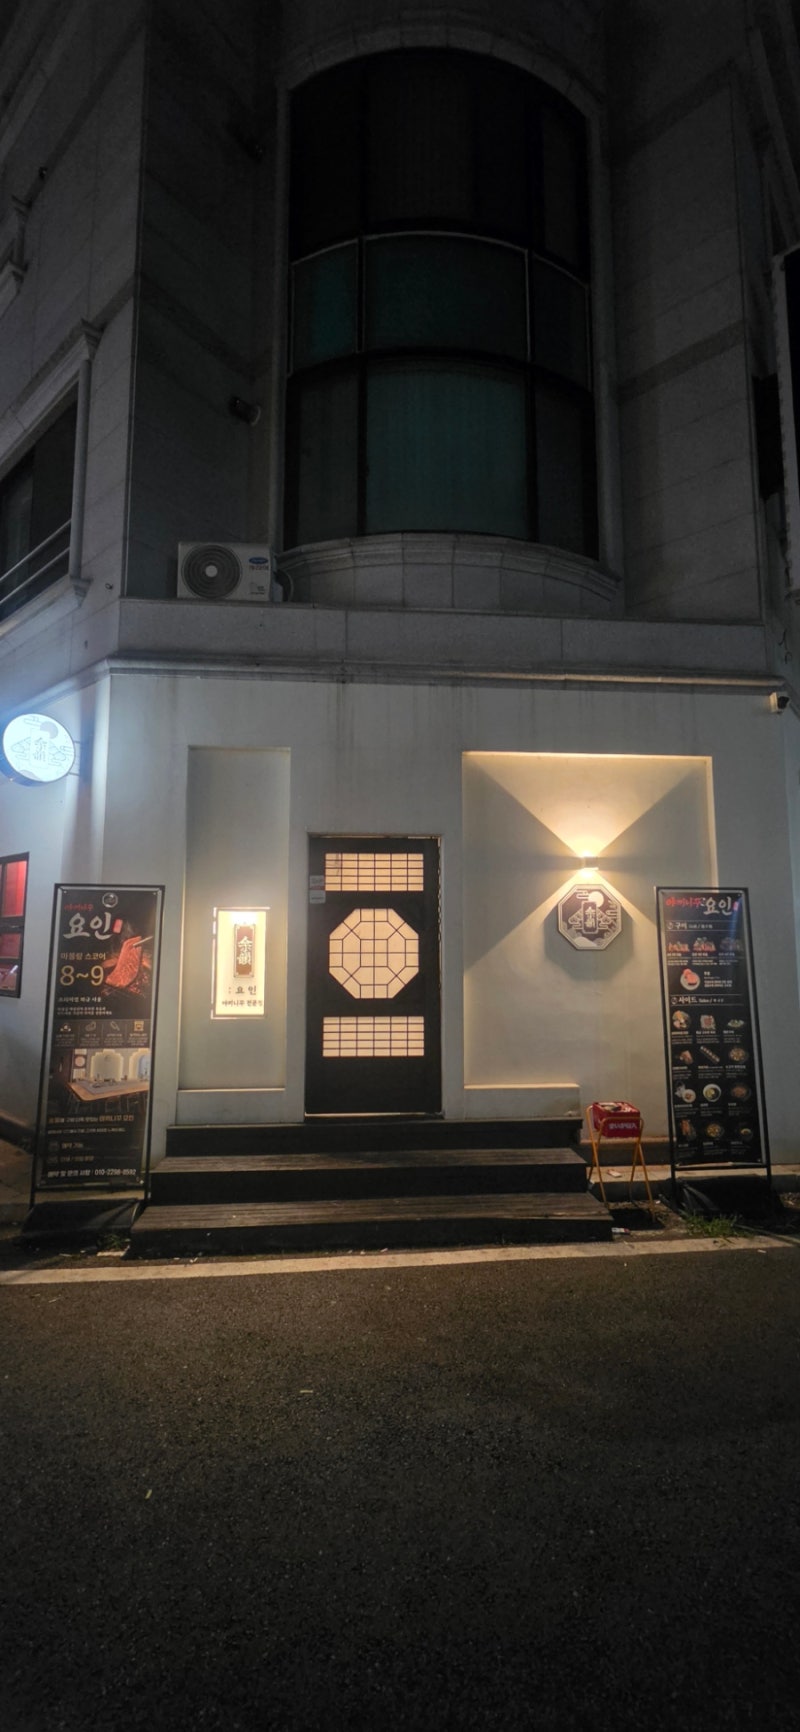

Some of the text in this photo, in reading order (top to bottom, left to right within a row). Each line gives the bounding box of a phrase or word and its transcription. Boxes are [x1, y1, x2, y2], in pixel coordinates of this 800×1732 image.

[703, 896, 733, 916] 요인
[63, 912, 113, 940] 요인
[60, 952, 106, 961] 마블링 스코어
[60, 965, 104, 987] 8~9
[679, 996, 698, 1005] 사이드
